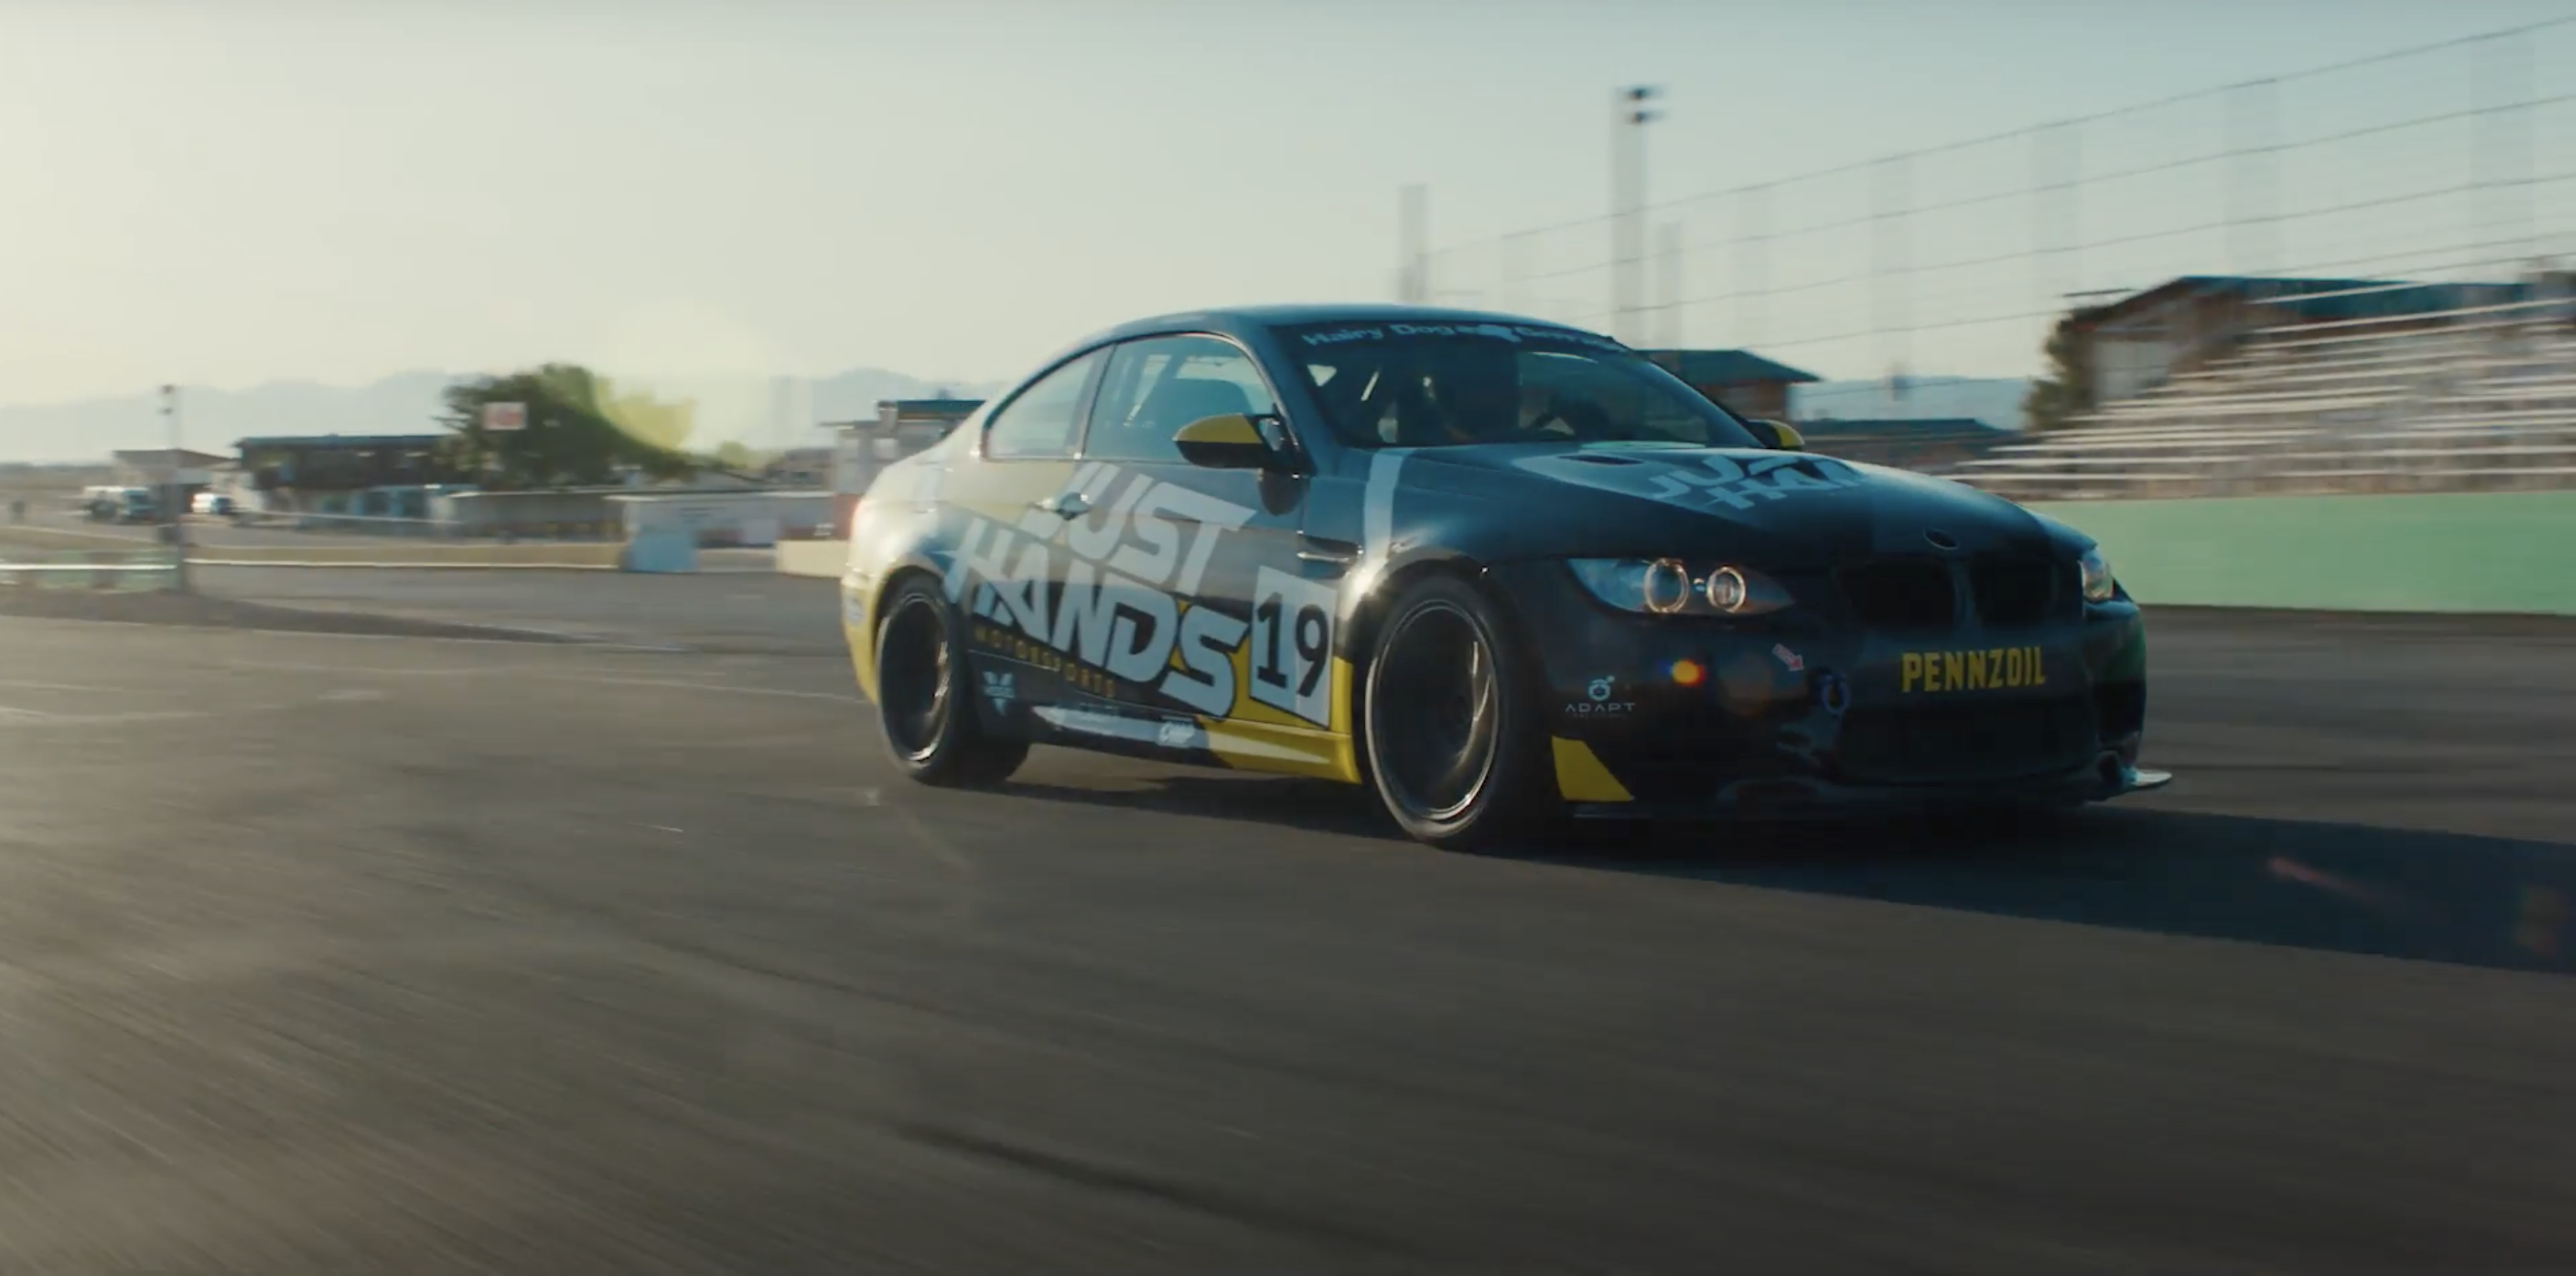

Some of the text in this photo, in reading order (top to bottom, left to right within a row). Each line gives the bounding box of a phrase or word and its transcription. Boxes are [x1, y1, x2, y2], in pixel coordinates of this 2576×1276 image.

[1301, 324, 1456, 346] Hairy Dog
[1019, 461, 1256, 596] JUST
[944, 518, 1250, 719] HANDS
[1256, 592, 1329, 697] 19
[1565, 702, 1636, 713] ADAPT
[1902, 646, 2045, 693] PENNZOIL
